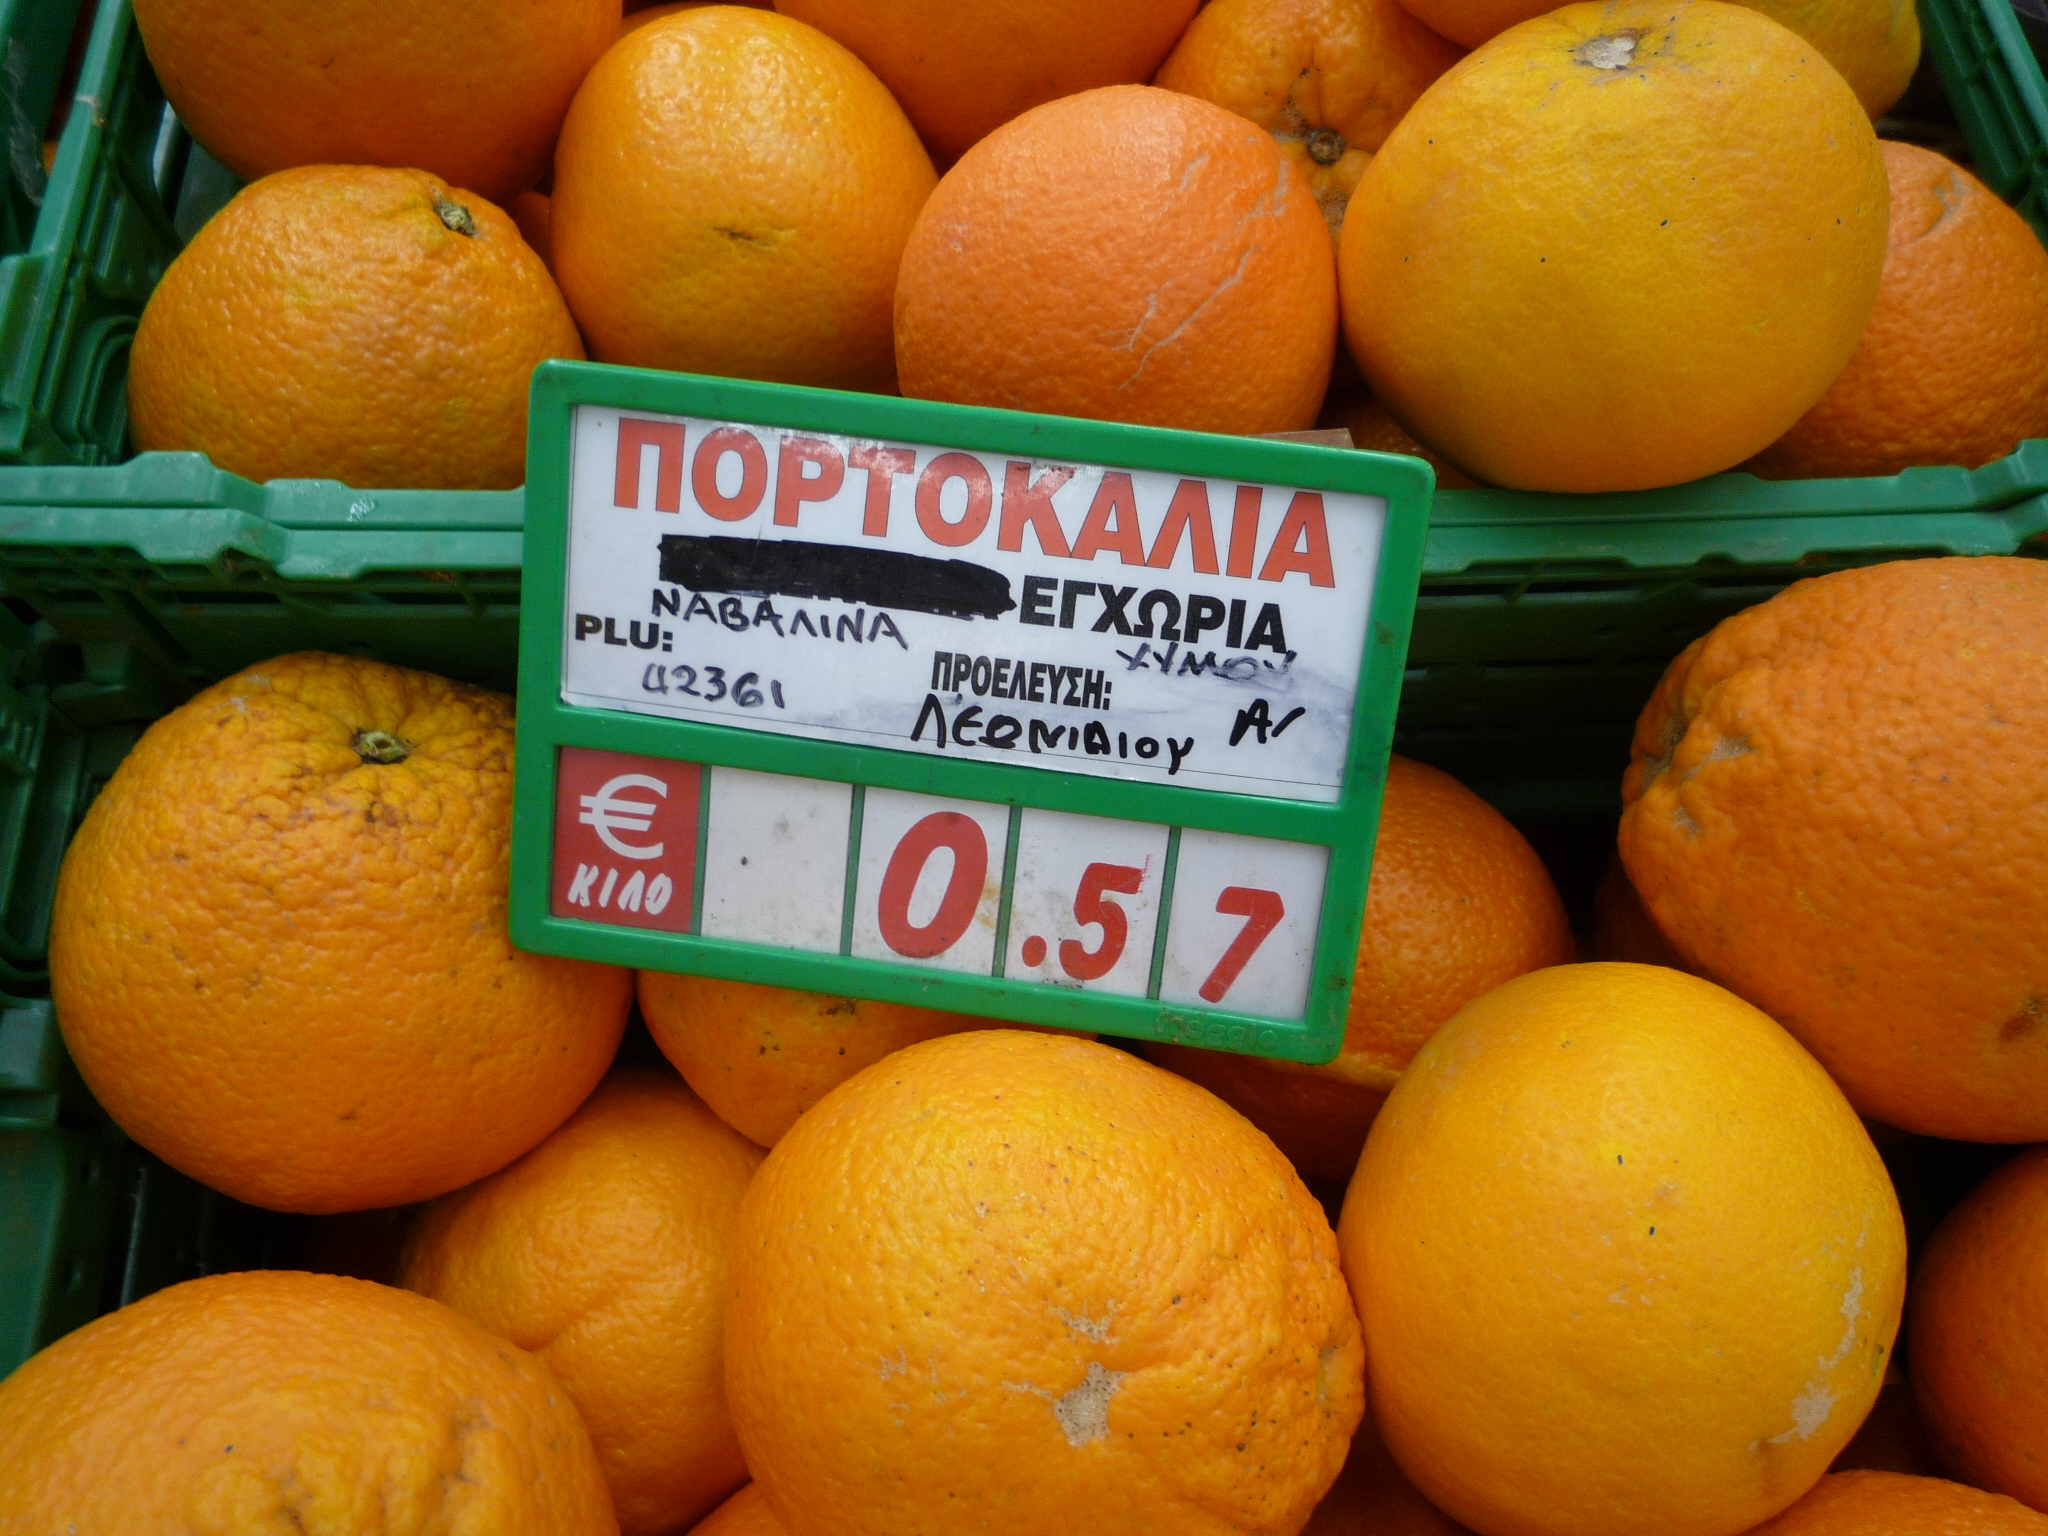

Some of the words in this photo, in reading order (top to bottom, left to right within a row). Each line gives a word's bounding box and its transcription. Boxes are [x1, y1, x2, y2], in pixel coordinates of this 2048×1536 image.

[614, 417, 1336, 588] ΠΟΡΤΟΚΑΛΙΑ
[574, 613, 674, 653] PLU:
[651, 588, 909, 651] ΝΑΒΑΛΙΝΑ
[1019, 574, 1288, 655] ΕΓΧΩΡΙΑ
[641, 662, 786, 708] 42361
[931, 650, 1113, 710] ΠΡΟΕΛΕΥΣΗ:
[579, 773, 668, 860] €
[567, 862, 673, 915] ΚΙΛΟ
